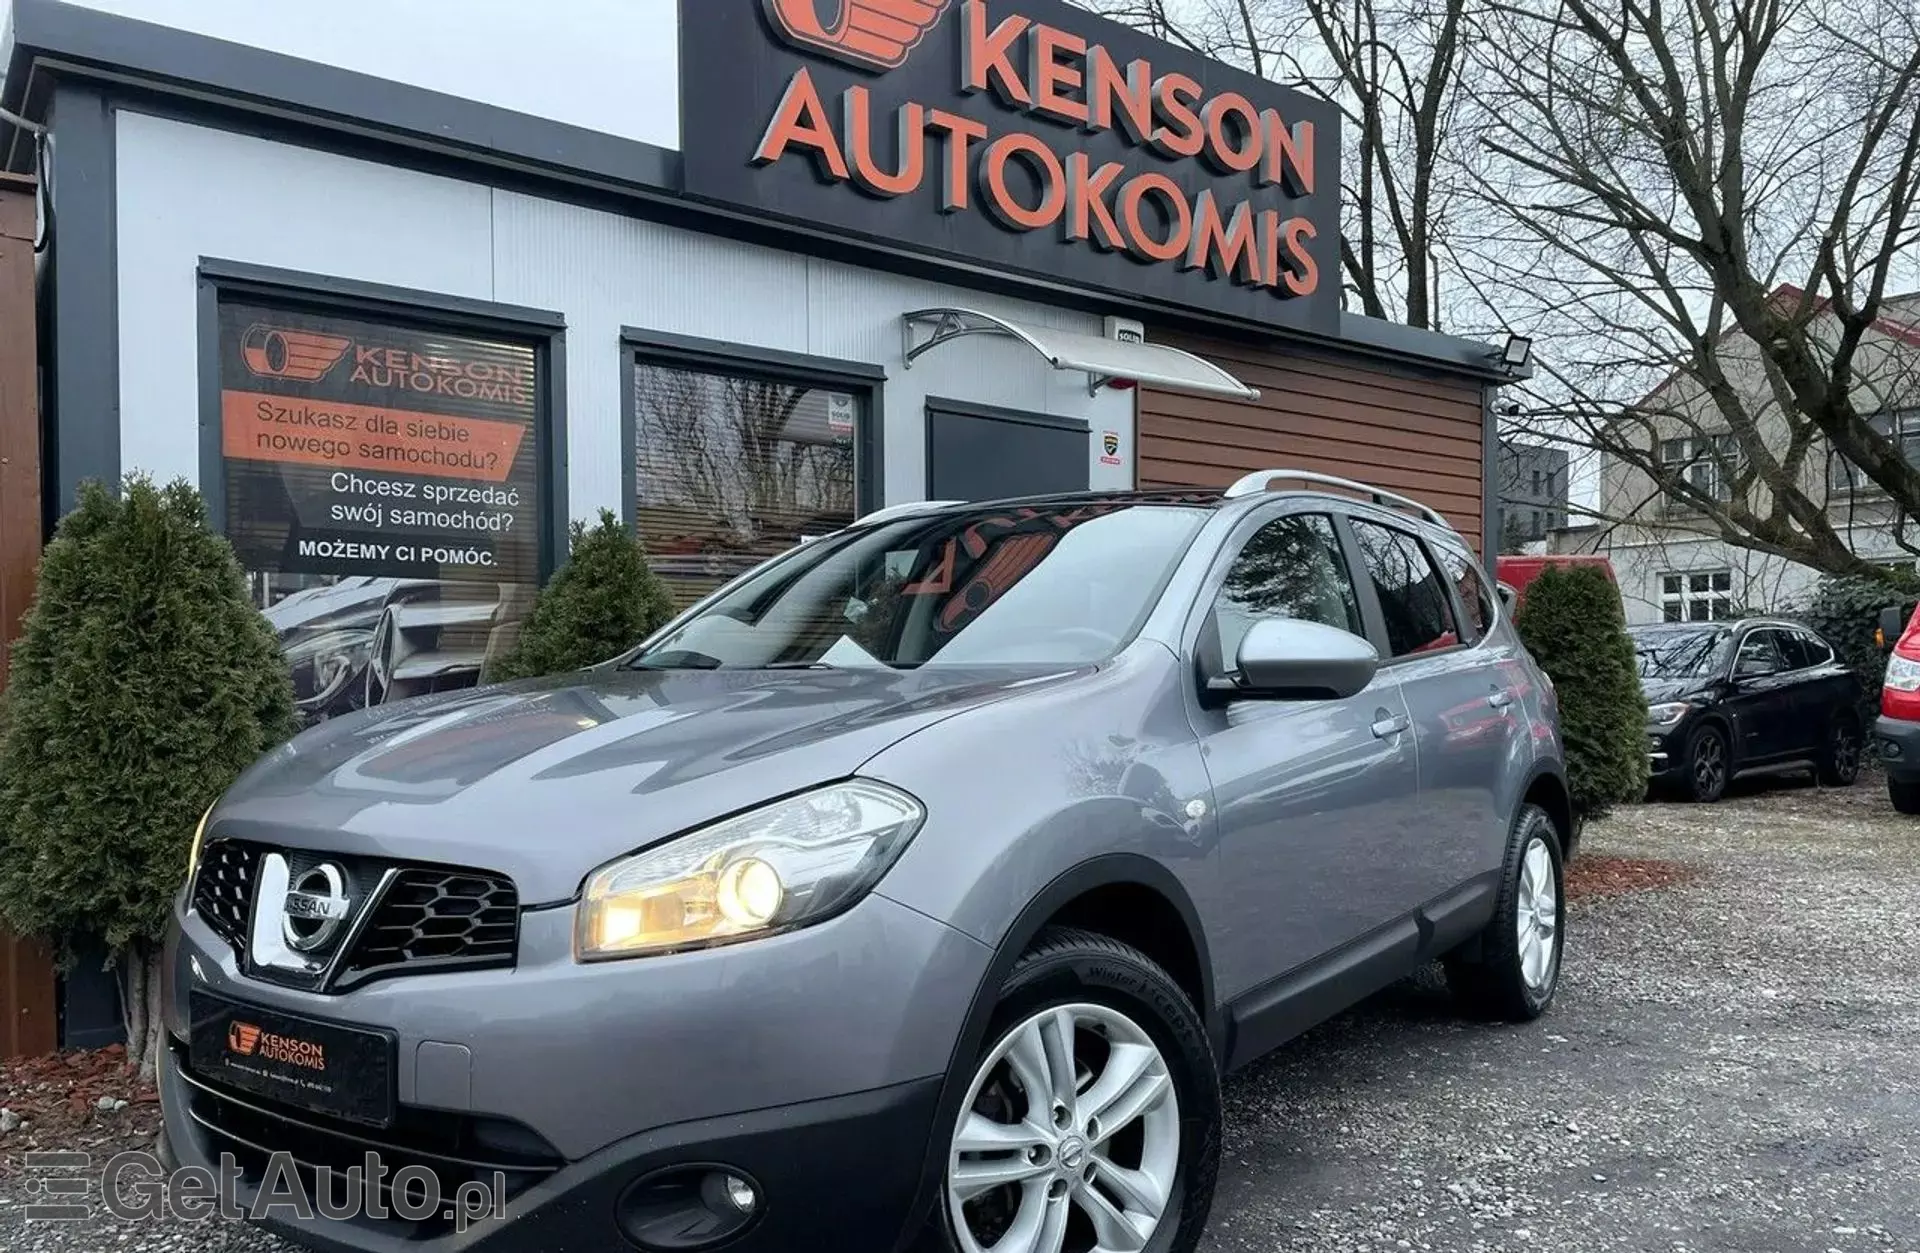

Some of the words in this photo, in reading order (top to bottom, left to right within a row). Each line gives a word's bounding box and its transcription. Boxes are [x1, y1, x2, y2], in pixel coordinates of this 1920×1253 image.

[961, 0, 1314, 195] KENSON
[752, 66, 1320, 297] AUTOKOMIS
[350, 365, 527, 404] AUTOKOMIS
[354, 346, 526, 385] KENSON
[256, 401, 357, 430] Szukasz
[365, 414, 399, 435] dla
[406, 421, 470, 443] siebie
[256, 431, 351, 459] nowego
[358, 442, 498, 470] samochodu?
[331, 472, 416, 498] Chcesz
[423, 482, 520, 507] sprzedać
[331, 503, 384, 527] swój
[390, 507, 513, 532] samochód?
[299, 539, 390, 561] MOŻEMY
[395, 546, 415, 562] CI
[421, 548, 498, 566] POMÓC.
[259, 1044, 325, 1071] AUTOKOMIS
[260, 1032, 323, 1057] KENSON
